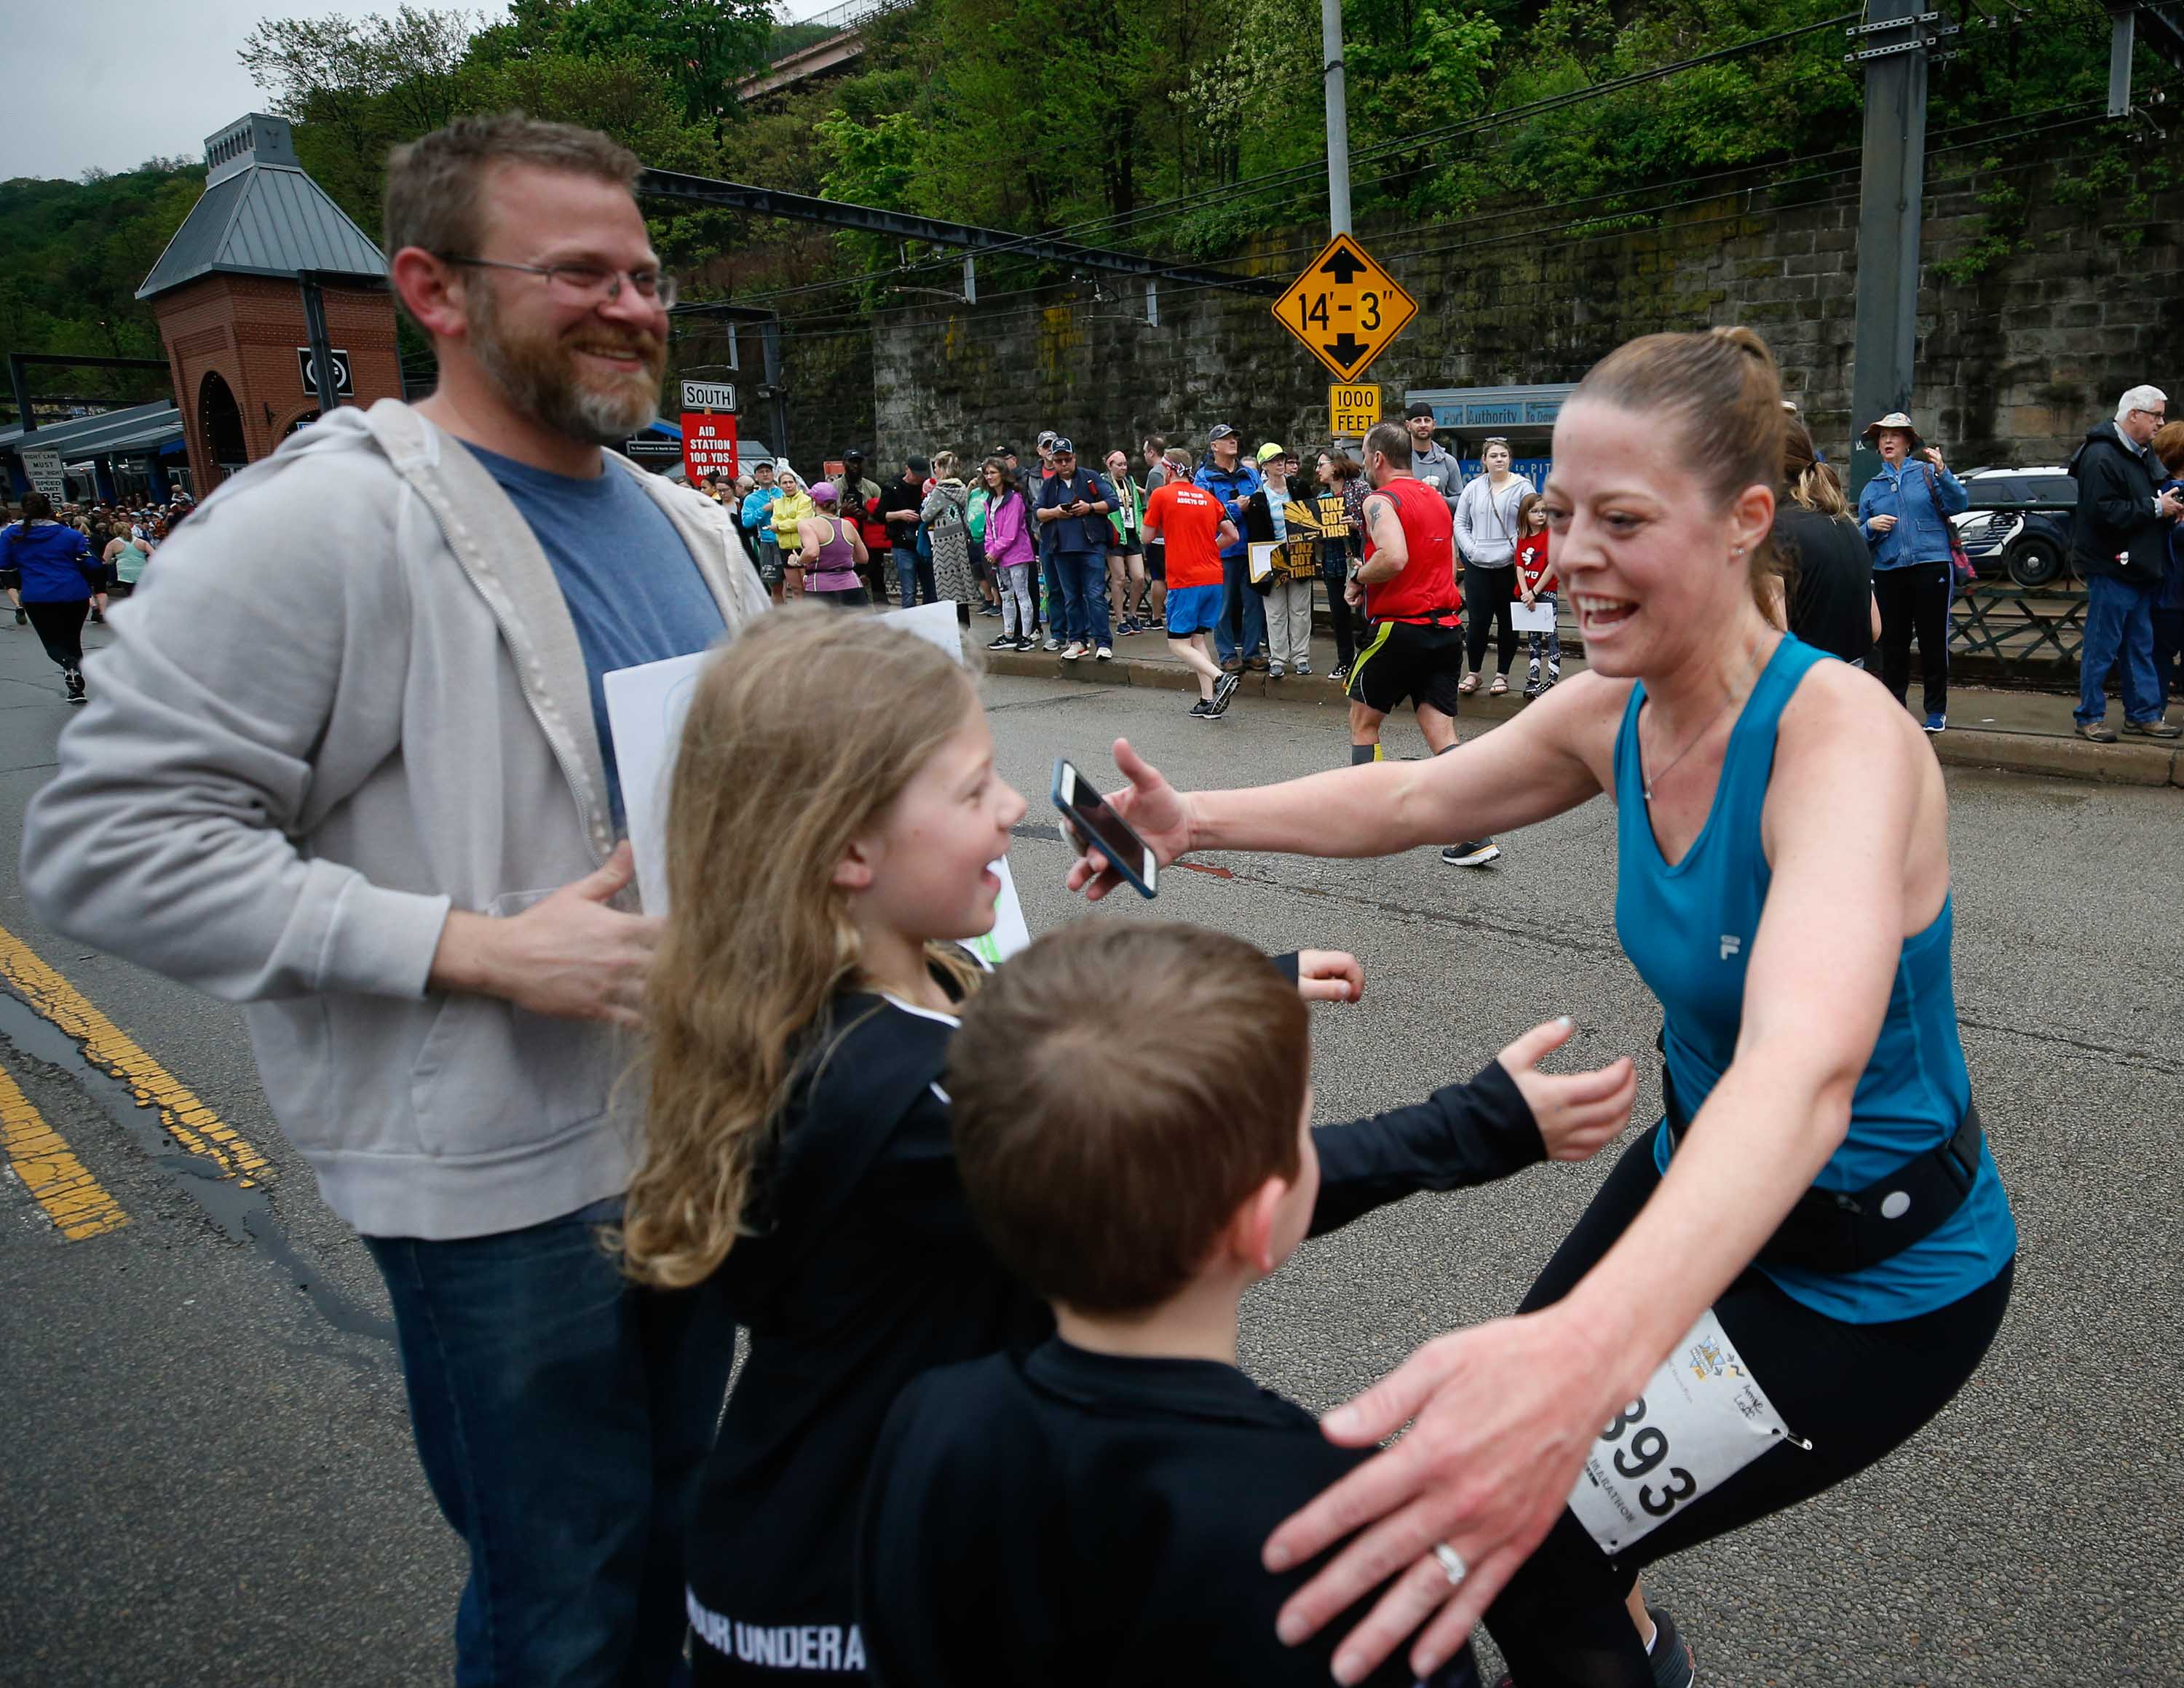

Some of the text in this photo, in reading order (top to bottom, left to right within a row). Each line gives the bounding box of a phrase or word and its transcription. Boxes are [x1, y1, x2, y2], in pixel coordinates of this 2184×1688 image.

[687, 386, 730, 405] SOUTH
[1337, 391, 1374, 407] 1000
[1338, 416, 1374, 430] FEET
[1467, 408, 1517, 424] Authority
[699, 426, 716, 437] AID
[689, 439, 731, 450] STATION
[689, 452, 733, 463] 100 YDS.
[697, 465, 728, 476] AHEAD
[1317, 496, 1345, 512] YINZ
[1321, 510, 1345, 526] GOT
[1321, 524, 1350, 538] THIS!
[1291, 554, 1312, 566] GOT
[1291, 565, 1316, 578] THIS!
[1590, 1458, 1636, 1523] MARATHON
